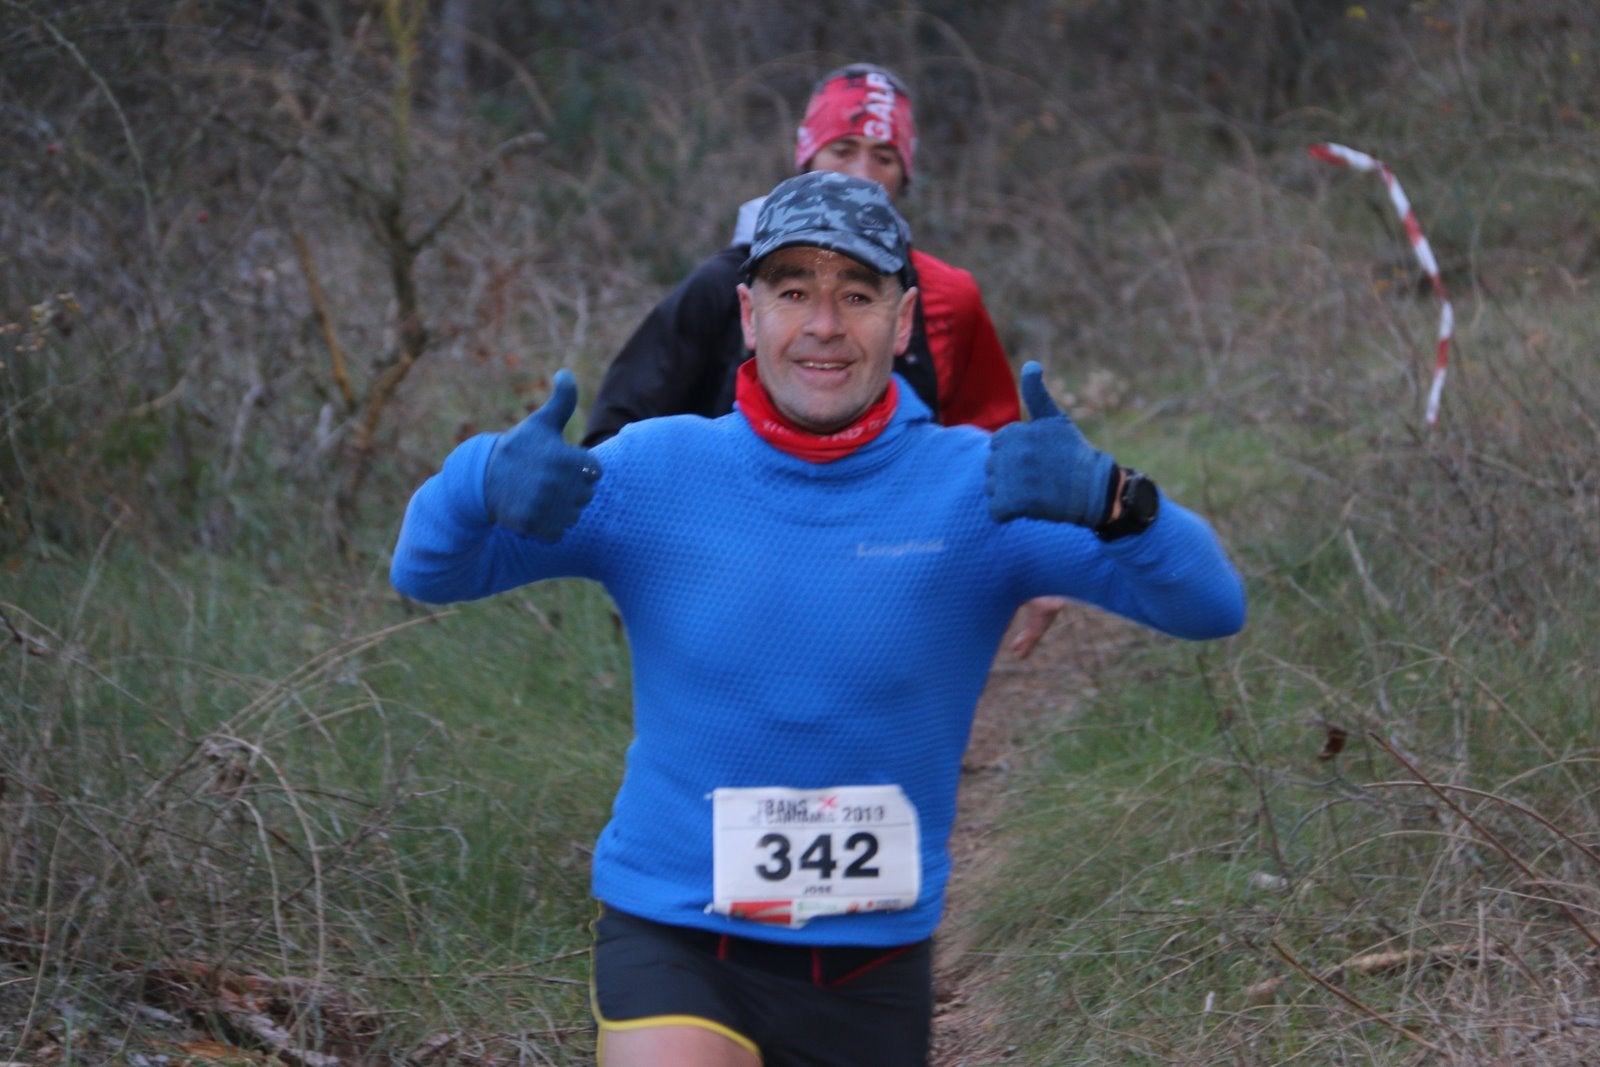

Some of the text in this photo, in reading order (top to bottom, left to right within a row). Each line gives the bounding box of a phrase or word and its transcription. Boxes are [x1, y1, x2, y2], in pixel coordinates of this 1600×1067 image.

[863, 72, 895, 142] GALP
[842, 804, 885, 822] 2019
[755, 832, 880, 882] 342
[803, 885, 833, 896] JOSE
